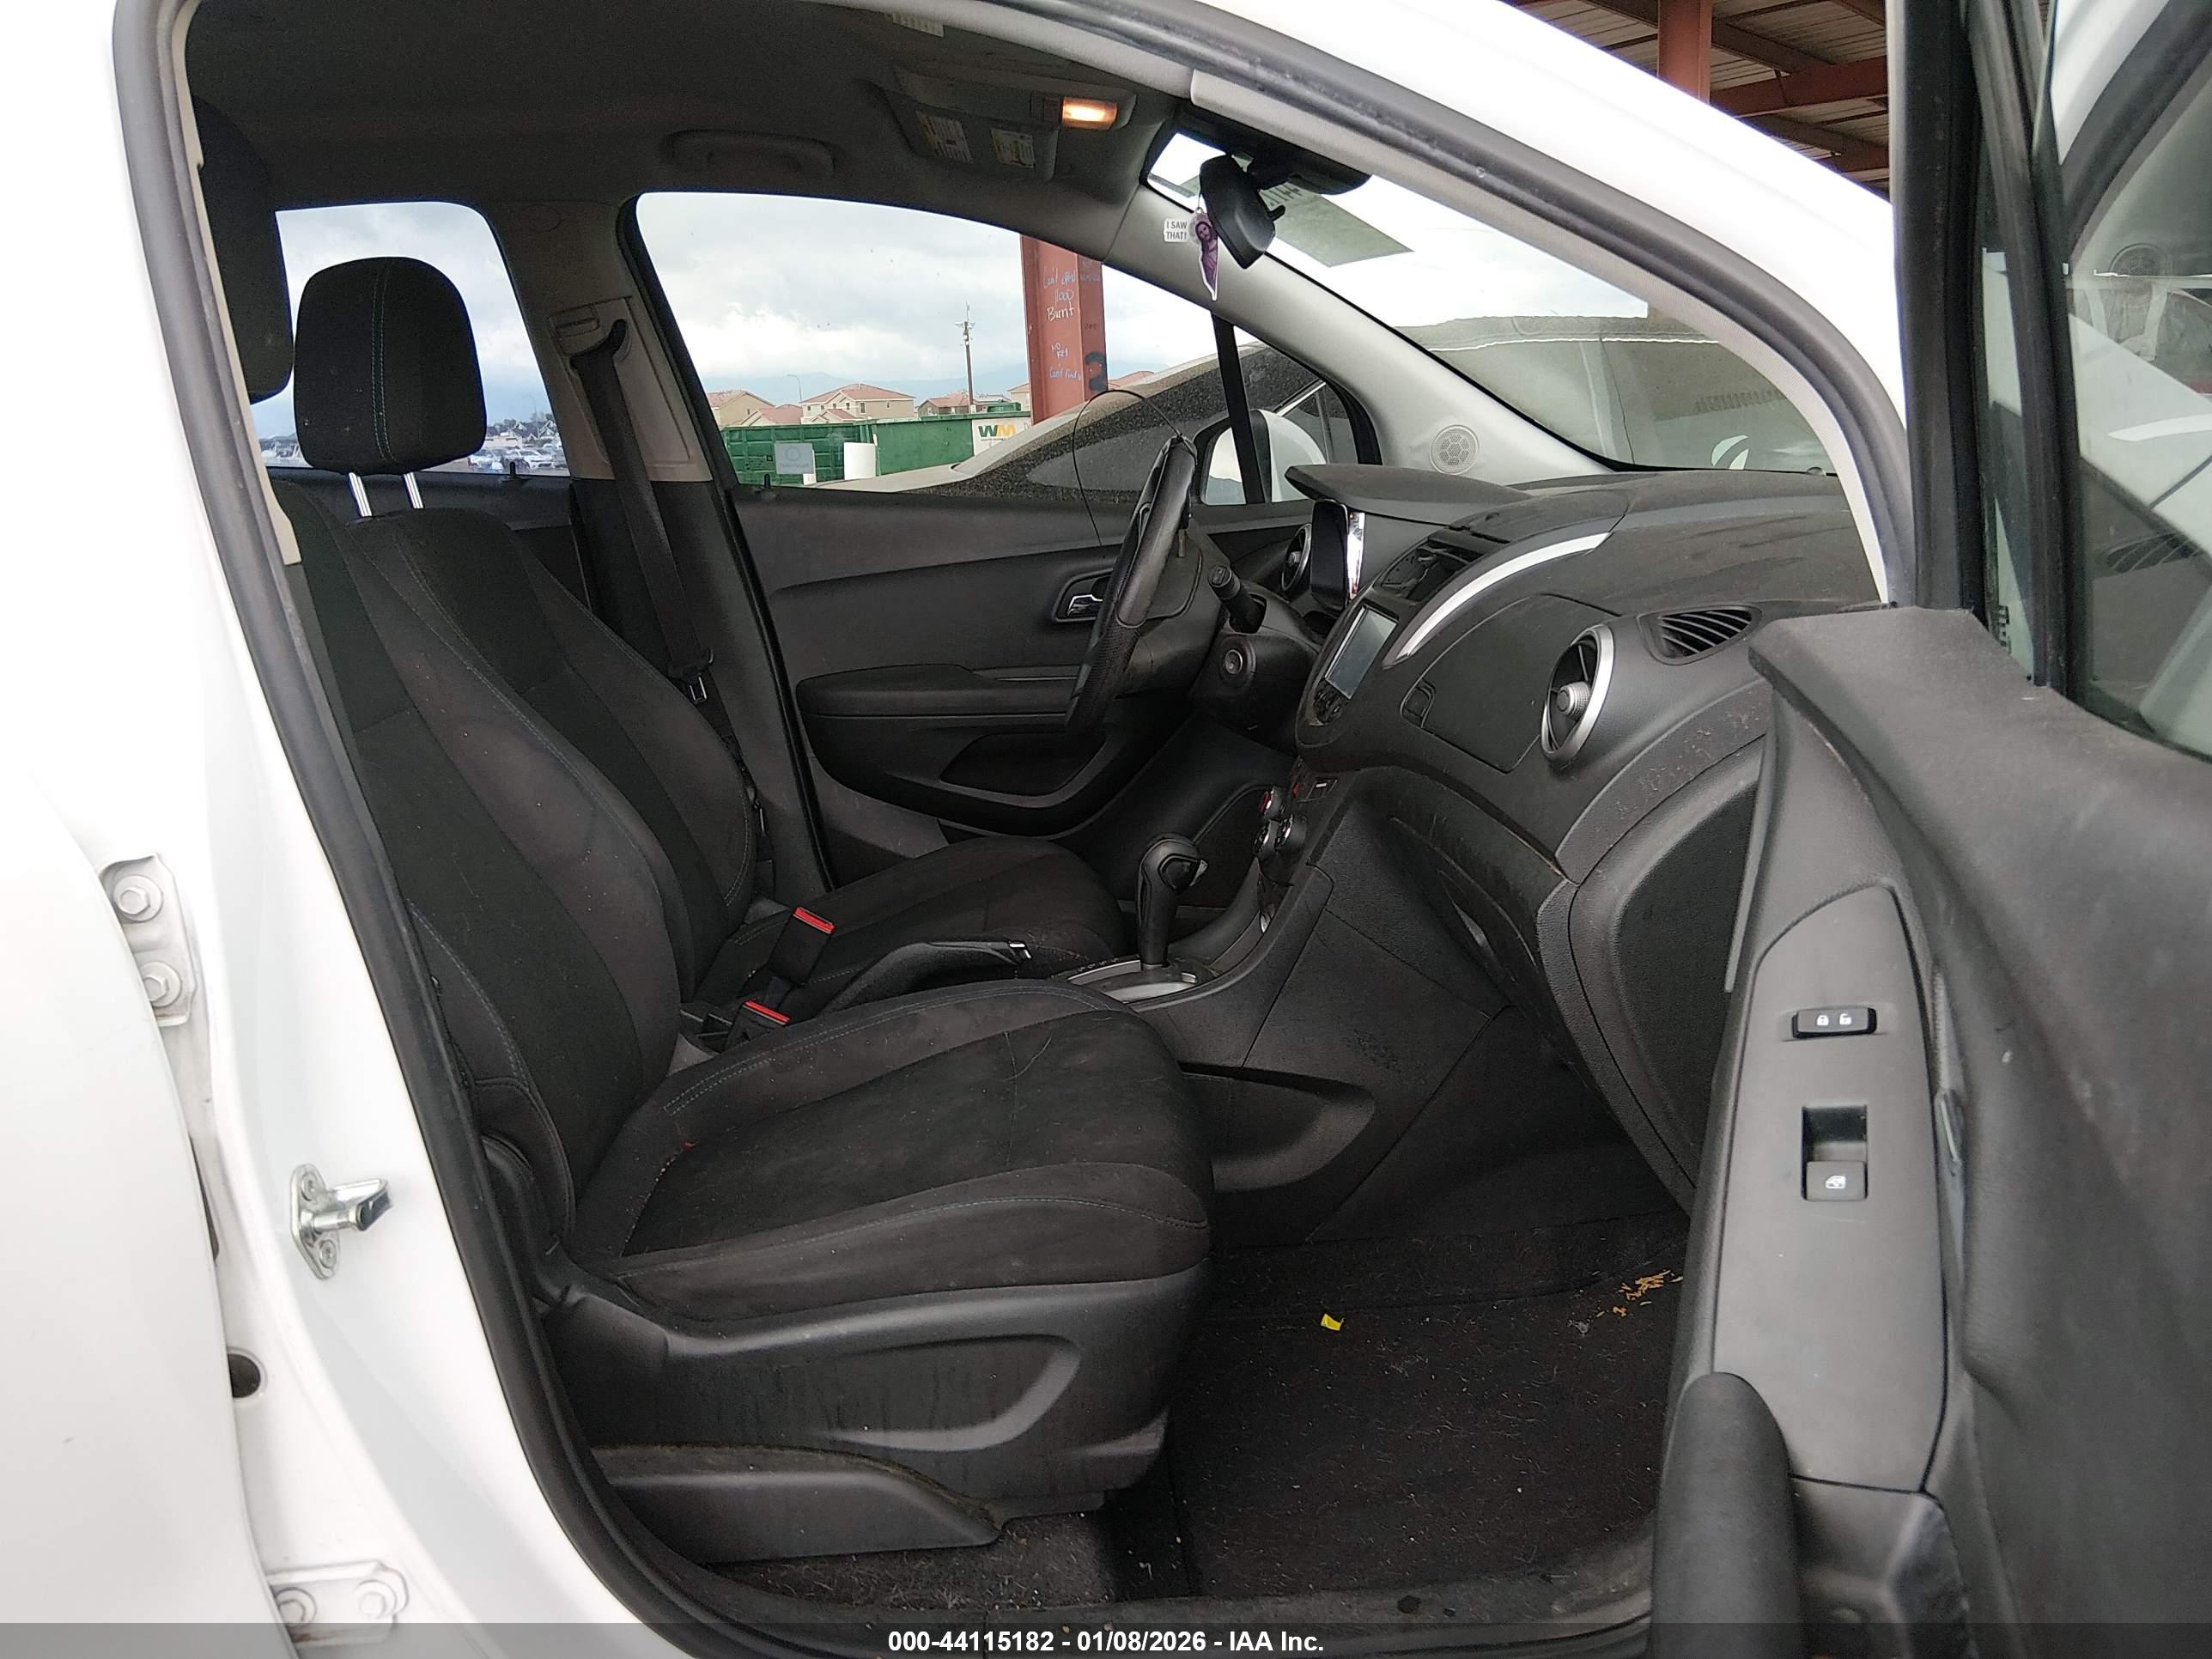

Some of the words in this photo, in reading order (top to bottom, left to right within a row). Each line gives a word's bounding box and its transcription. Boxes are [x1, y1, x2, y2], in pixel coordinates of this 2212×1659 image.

[1171, 221, 1188, 229] SAW
[1167, 231, 1187, 240] THAT!
[1047, 301, 1074, 322] Burnt
[978, 424, 1016, 437] WM
